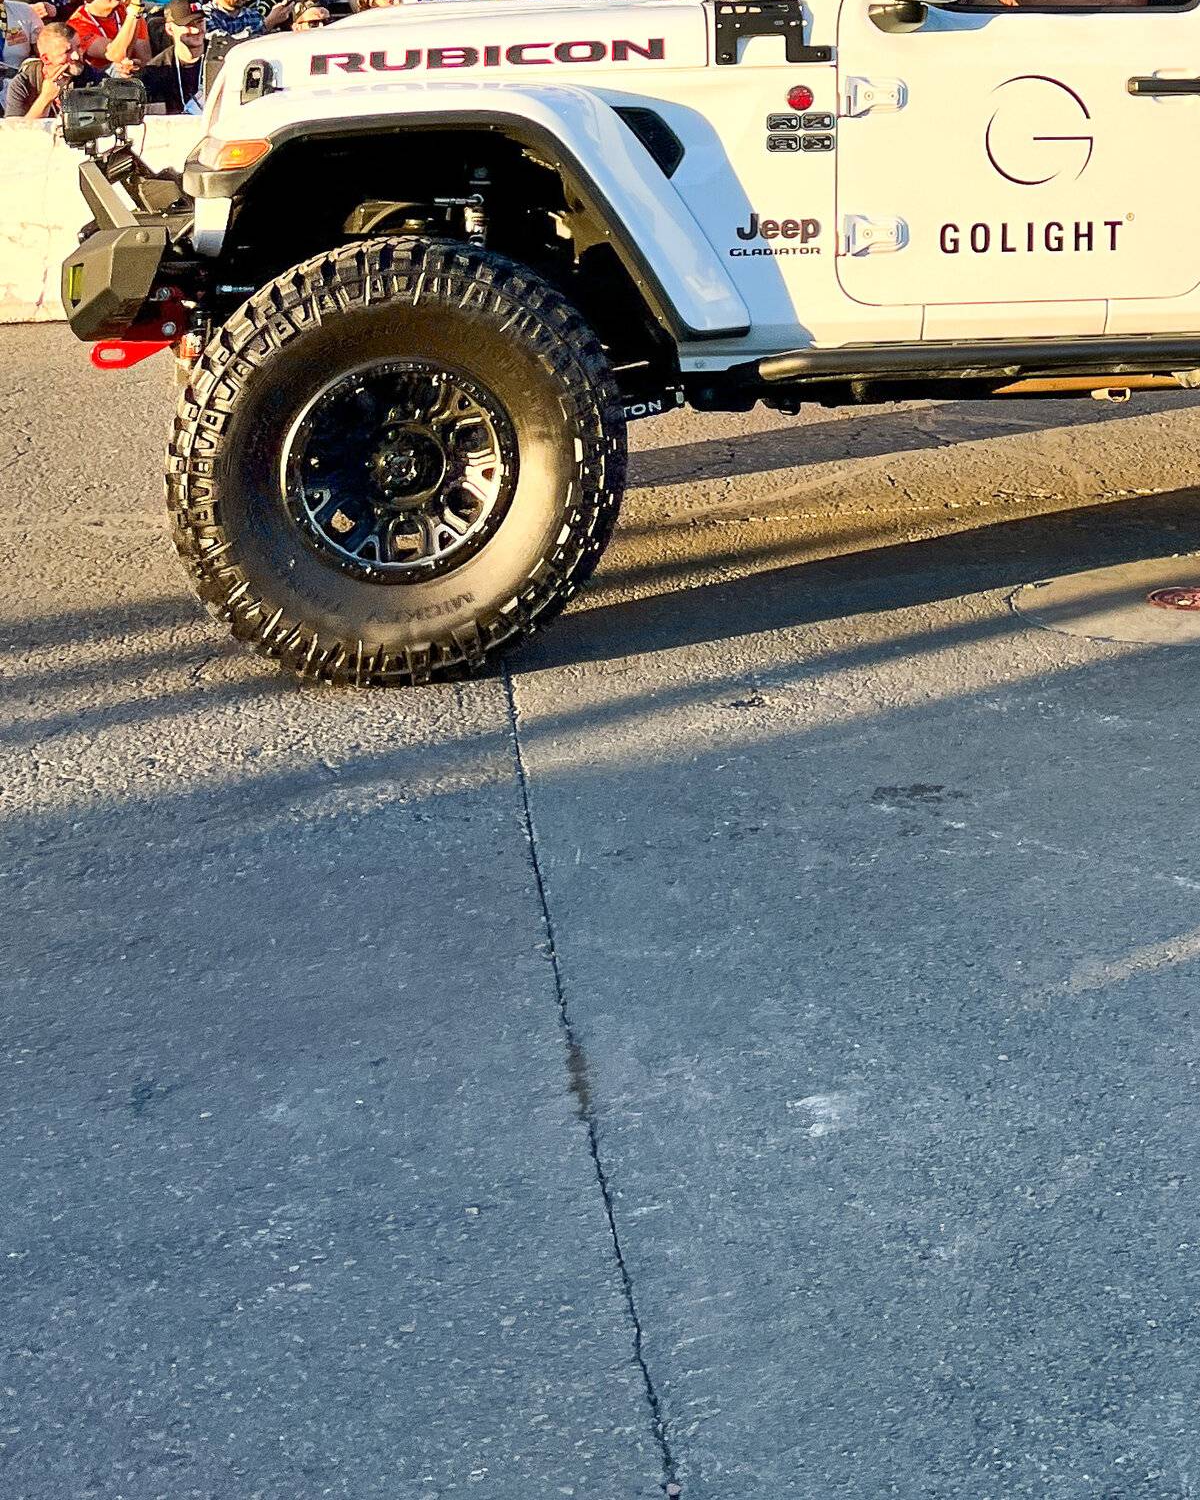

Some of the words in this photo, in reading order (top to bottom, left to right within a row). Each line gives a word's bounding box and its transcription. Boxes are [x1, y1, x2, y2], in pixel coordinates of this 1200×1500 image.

[309, 38, 665, 76] RUBICON
[736, 213, 821, 243] Jeep
[729, 247, 821, 257] GLADIATOR
